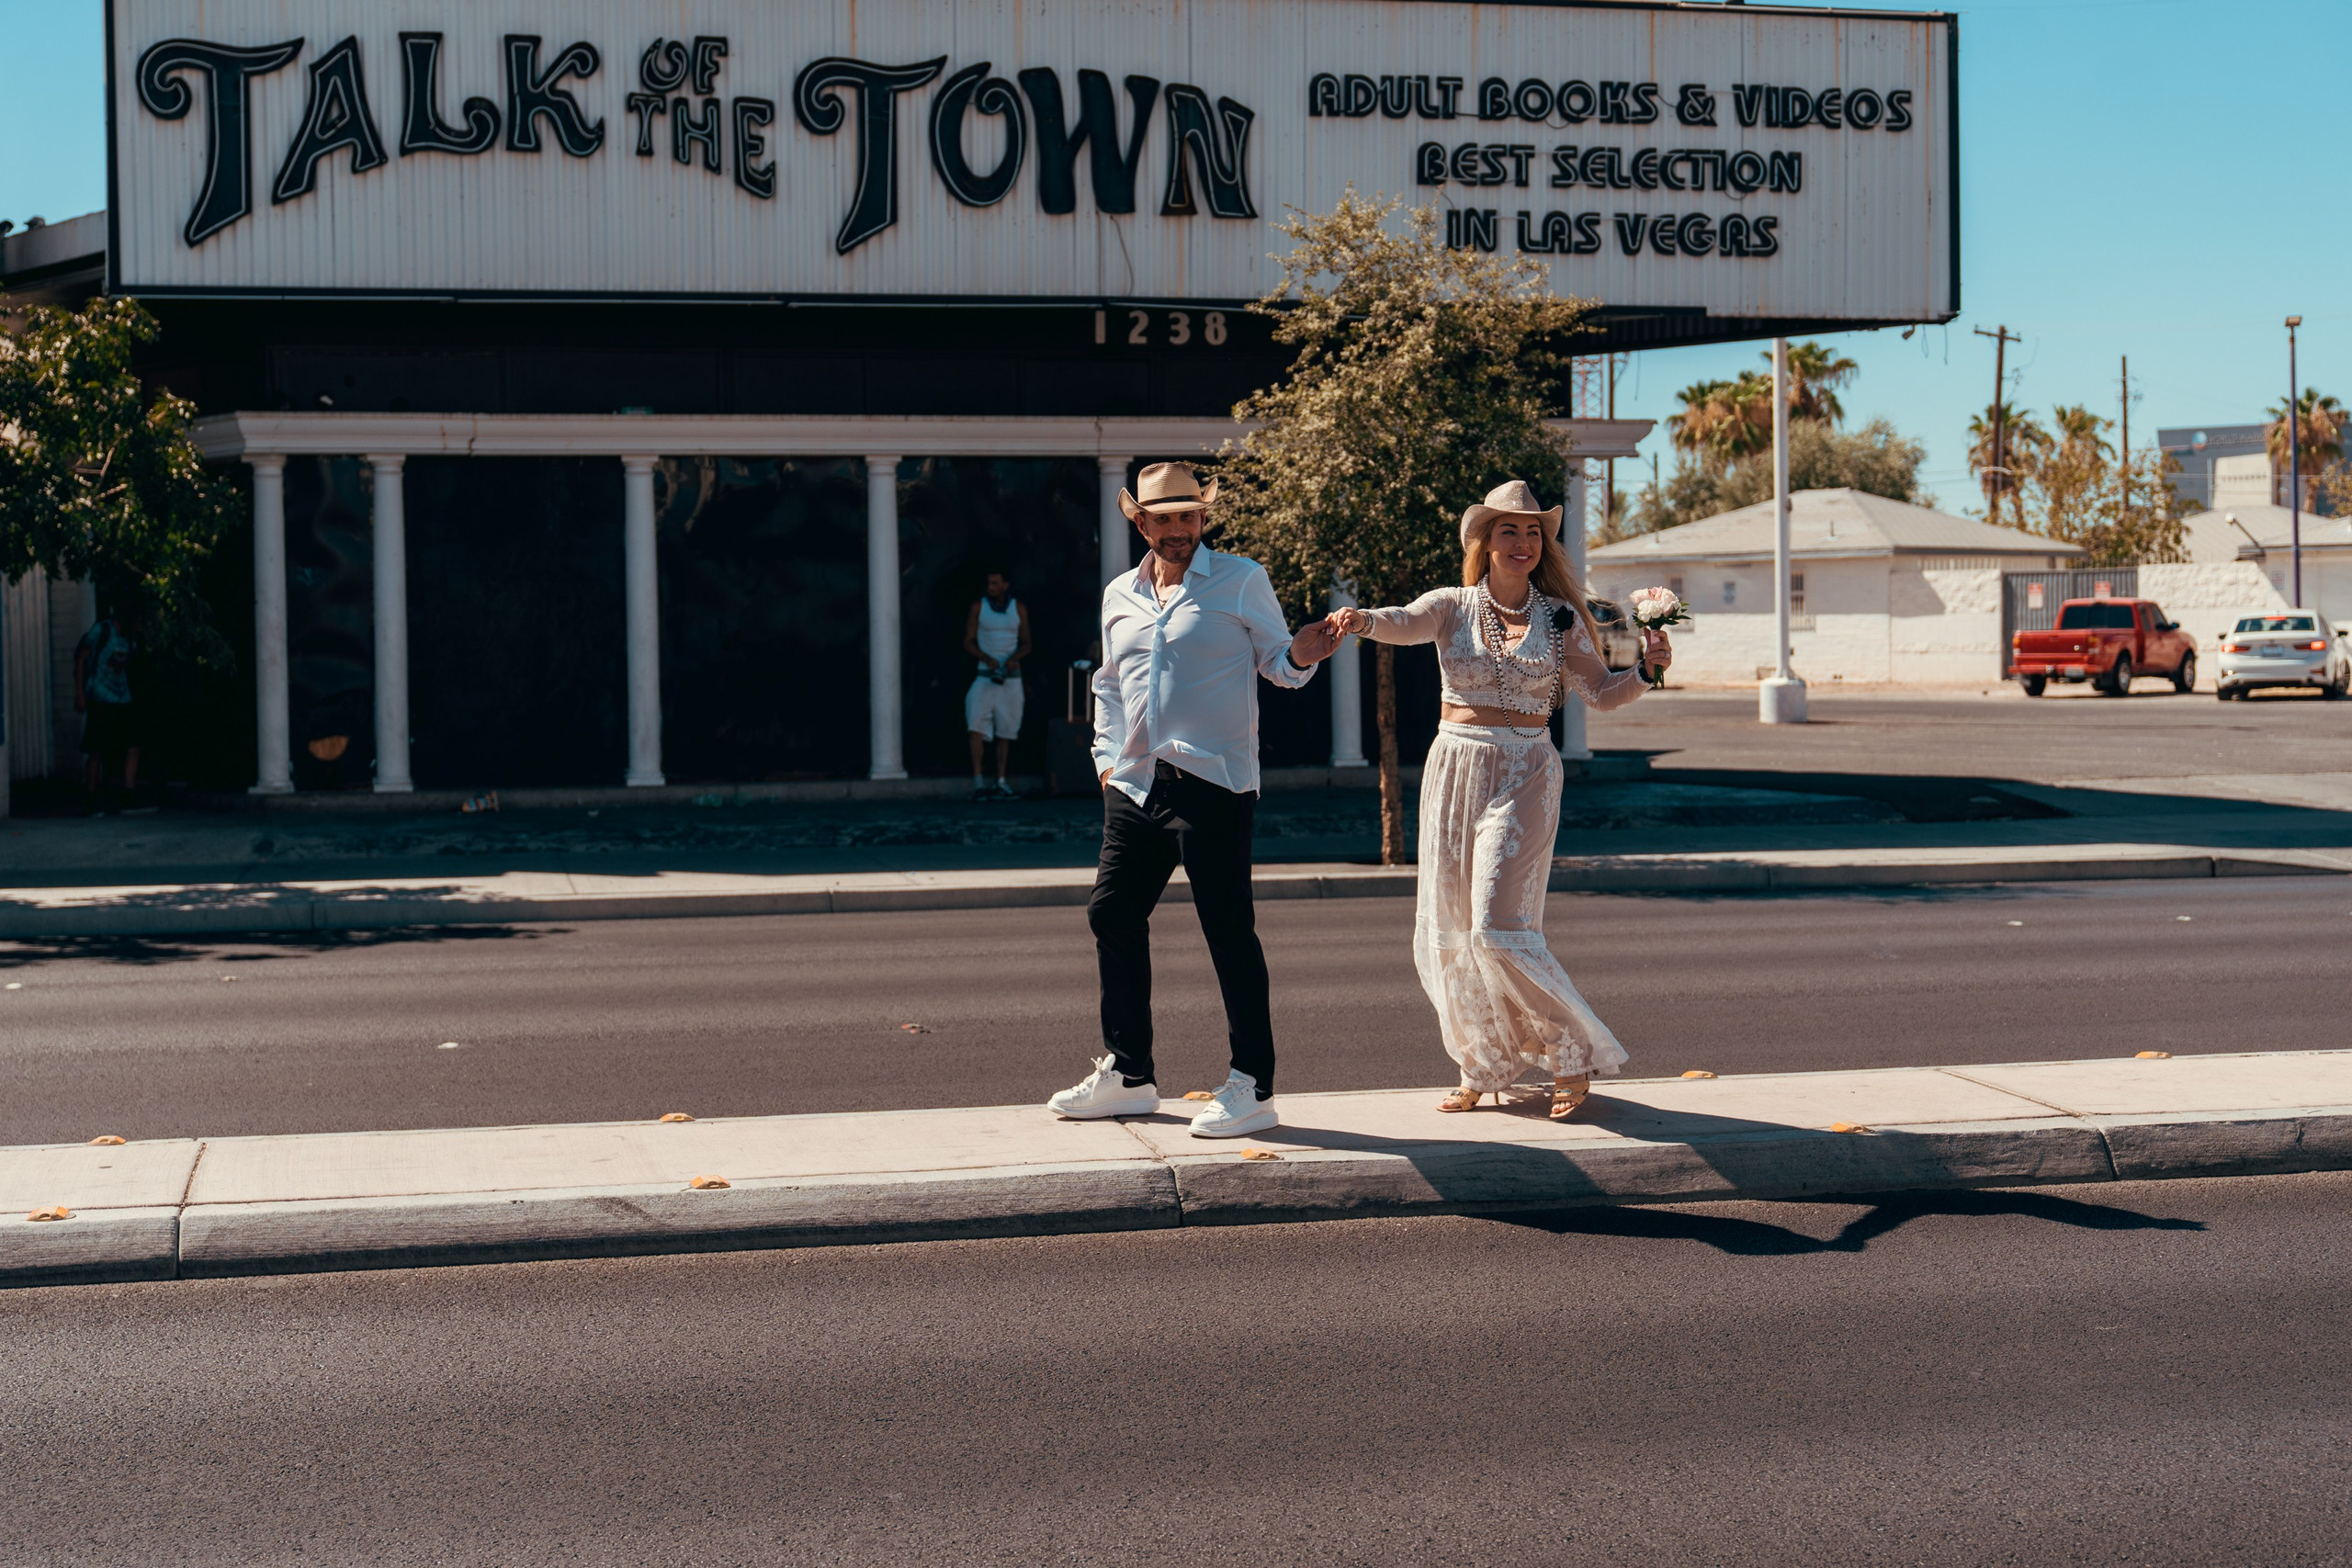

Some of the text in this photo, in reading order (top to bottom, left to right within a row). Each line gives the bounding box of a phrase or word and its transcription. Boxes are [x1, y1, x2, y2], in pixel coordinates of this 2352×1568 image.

[1309, 73, 1912, 132] ADULT BOOKS & VIDEOS
[135, 31, 1259, 256] TALK OF THE TOWN
[1417, 142, 1802, 193] BEST SELECTION
[1447, 209, 1778, 257] IN LAS VEGAS
[1094, 310, 1227, 345] 1238
